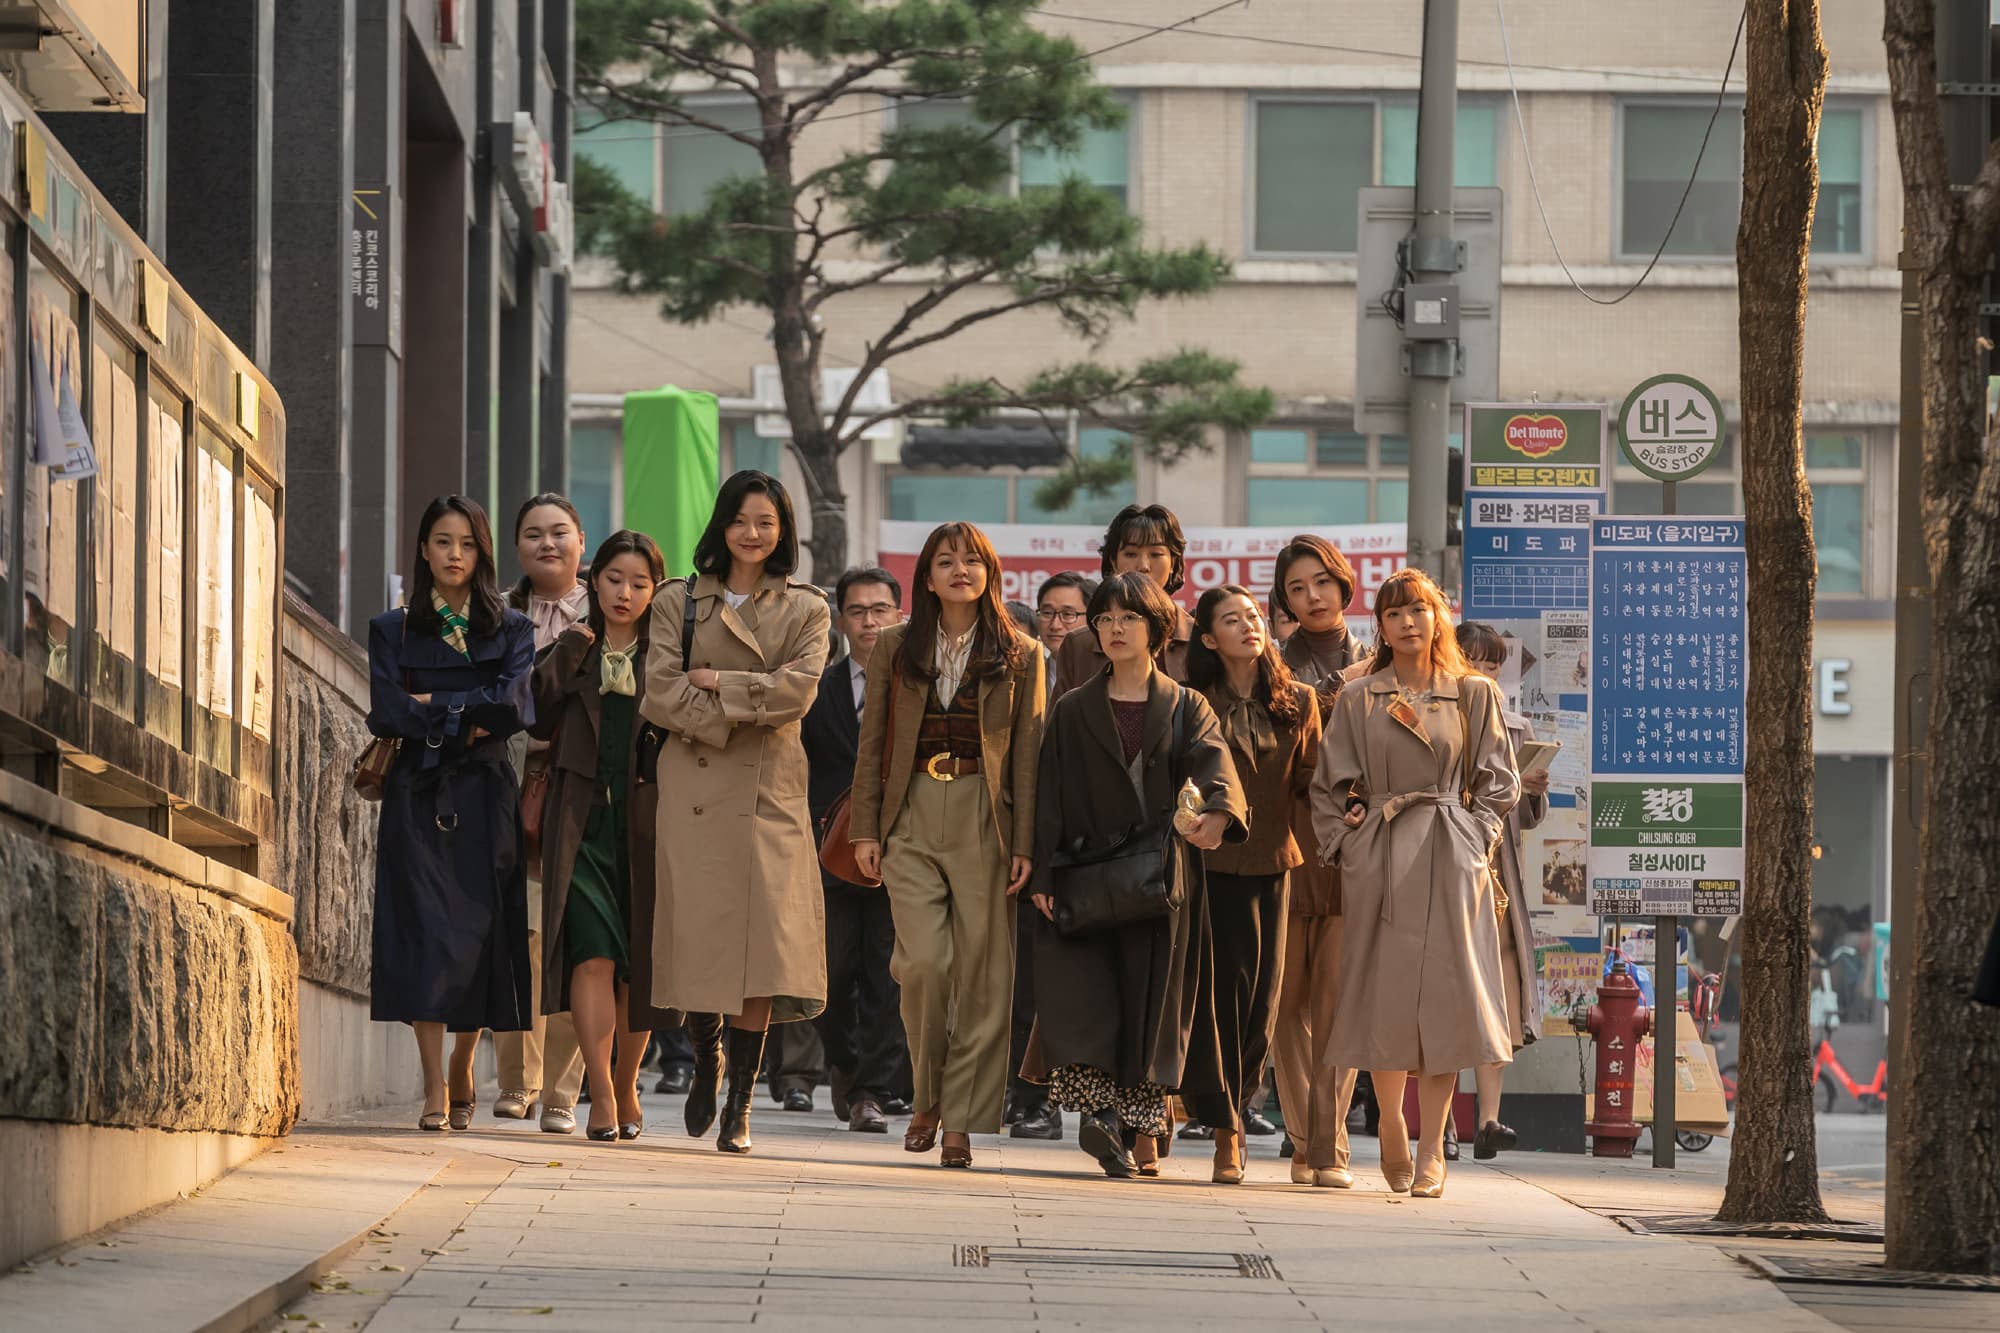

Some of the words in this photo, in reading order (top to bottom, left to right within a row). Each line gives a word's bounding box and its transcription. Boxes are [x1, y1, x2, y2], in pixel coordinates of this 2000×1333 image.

[365, 230, 379, 310] 킨코스코리아
[1509, 426, 1527, 439] Del
[1528, 426, 1564, 439] Monte
[1639, 399, 1707, 438] 버스
[1639, 448, 1668, 469] BUS
[1672, 446, 1706, 470] STOP
[1476, 467, 1595, 487] 델몬트오렌지
[1601, 525, 1652, 543] 미도파
[1657, 525, 1739, 543] (을지입구)
[1702, 561, 1712, 617] 신당역
[1715, 561, 1726, 617] 청구역
[1689, 633, 1699, 690] 서울역
[1642, 787, 1693, 823] 칠성
[1638, 832, 1674, 844] CHILSUNG
[1675, 832, 1697, 844] CIDER
[1628, 853, 1706, 872] 칠성사이다
[1607, 1035, 1626, 1107] 소화전
